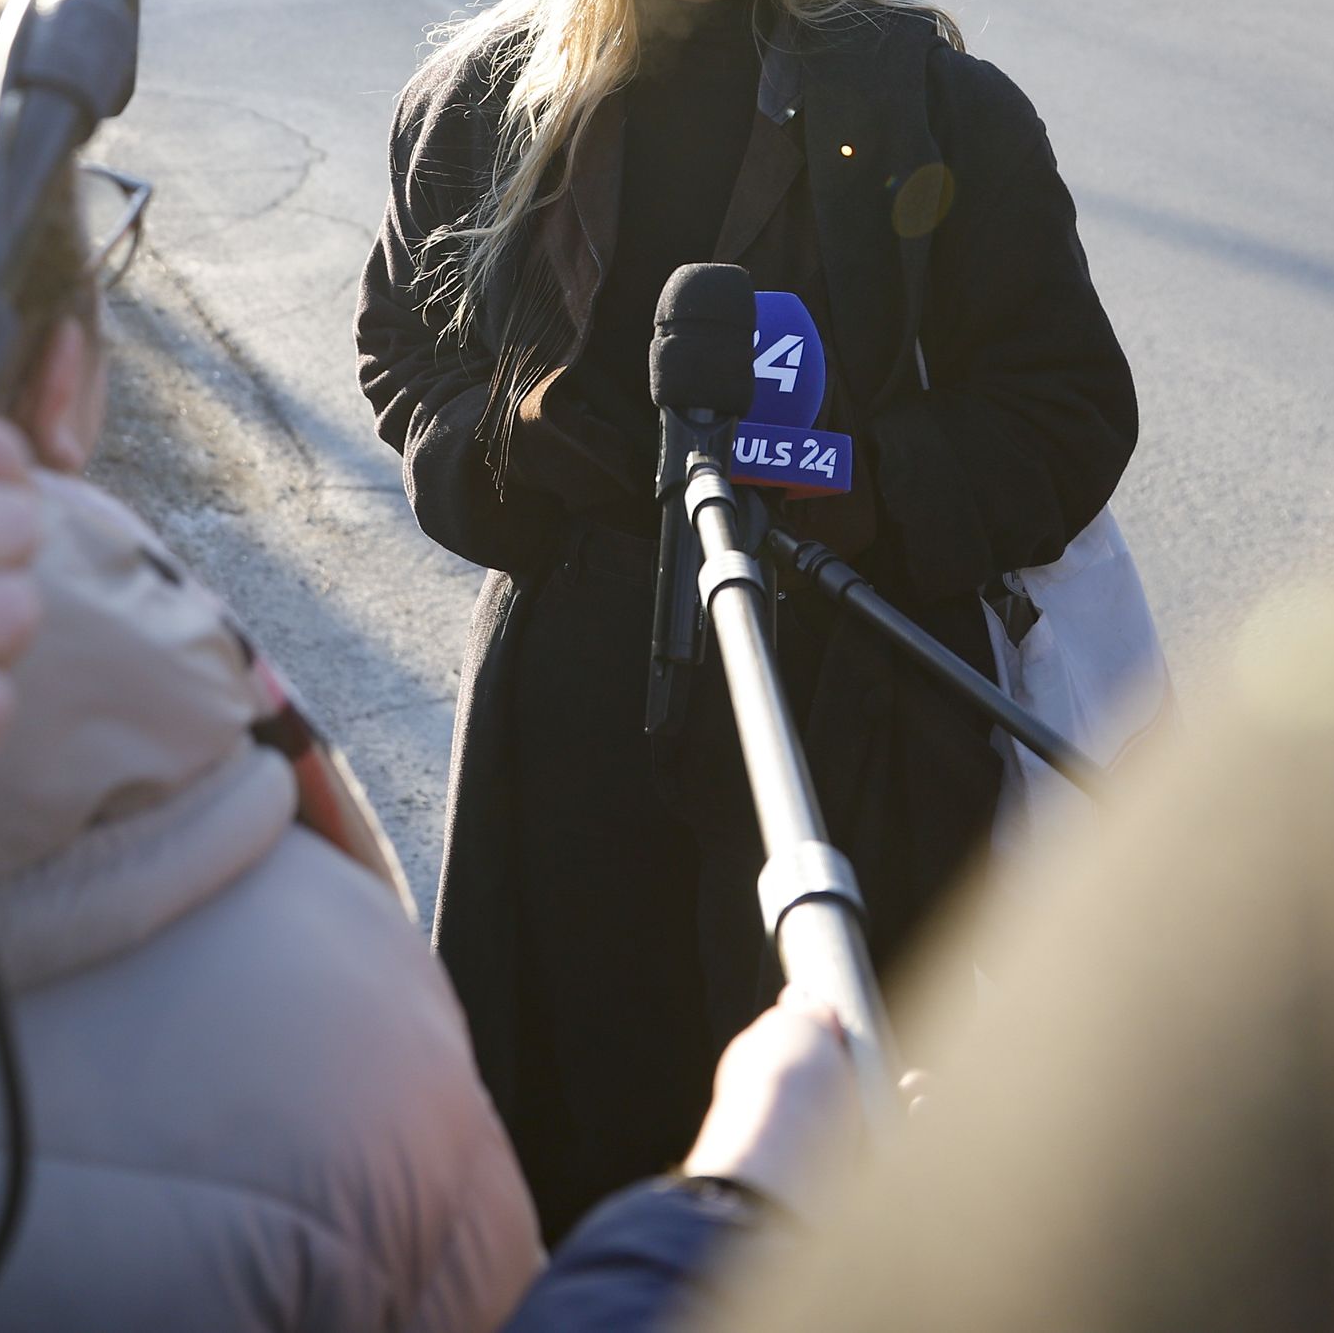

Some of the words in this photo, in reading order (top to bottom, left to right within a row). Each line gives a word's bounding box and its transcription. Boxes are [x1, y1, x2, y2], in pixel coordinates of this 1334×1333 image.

[753, 329, 804, 393] 4
[732, 437, 793, 467] ULS
[799, 438, 837, 479] 24
